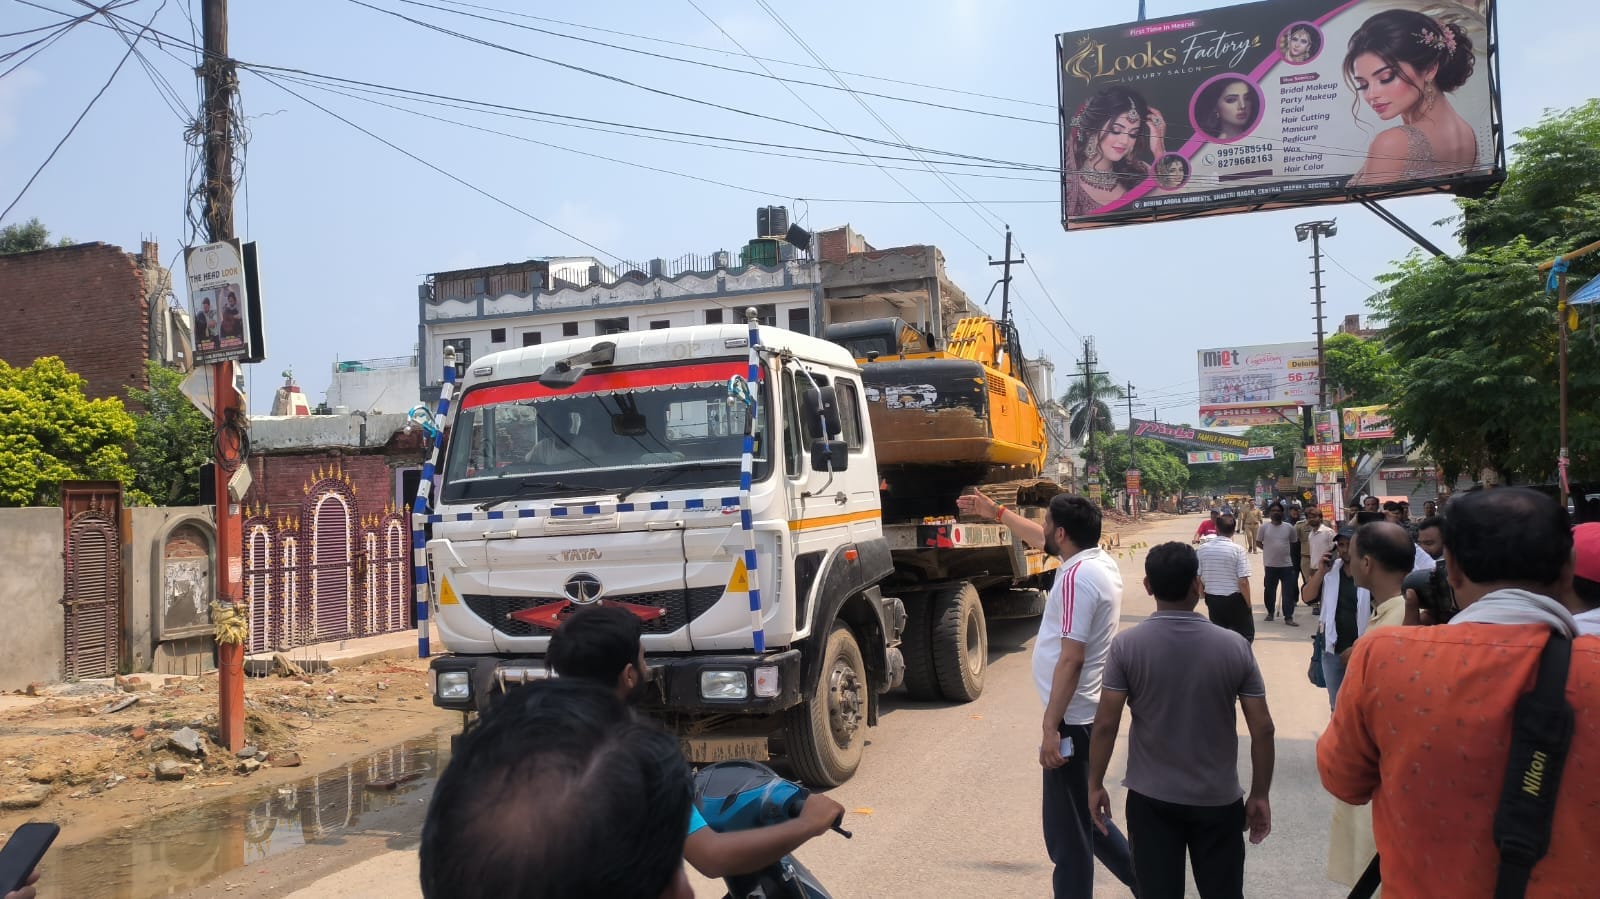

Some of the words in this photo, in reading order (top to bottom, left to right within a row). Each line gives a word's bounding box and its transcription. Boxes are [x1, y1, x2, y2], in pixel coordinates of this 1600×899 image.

[1095, 40, 1177, 77] Looks
[1180, 30, 1250, 69] Factory
[1121, 72, 1162, 83] LUXURY
[1168, 66, 1202, 75] SALON
[1280, 85, 1304, 95] Bridal
[1306, 82, 1338, 91] Makeup
[1280, 96, 1303, 104] Party
[1305, 92, 1337, 101] Makeup
[1281, 105, 1304, 114] Facial
[1300, 113, 1330, 122] Cutting
[1282, 124, 1319, 134] Manicure
[1282, 135, 1317, 144] Pedicure
[1283, 153, 1323, 163] Bleaching
[1303, 163, 1324, 171] Color
[203, 271, 220, 281] HEAD
[222, 267, 239, 277] LOOK
[1197, 433, 1217, 443] FAMILY
[1217, 436, 1249, 449] FOOTWEAR
[1307, 445, 1321, 453] FOR
[1322, 444, 1339, 452] RENT
[561, 548, 602, 561] TATA
[1522, 750, 1546, 797] Nikon
